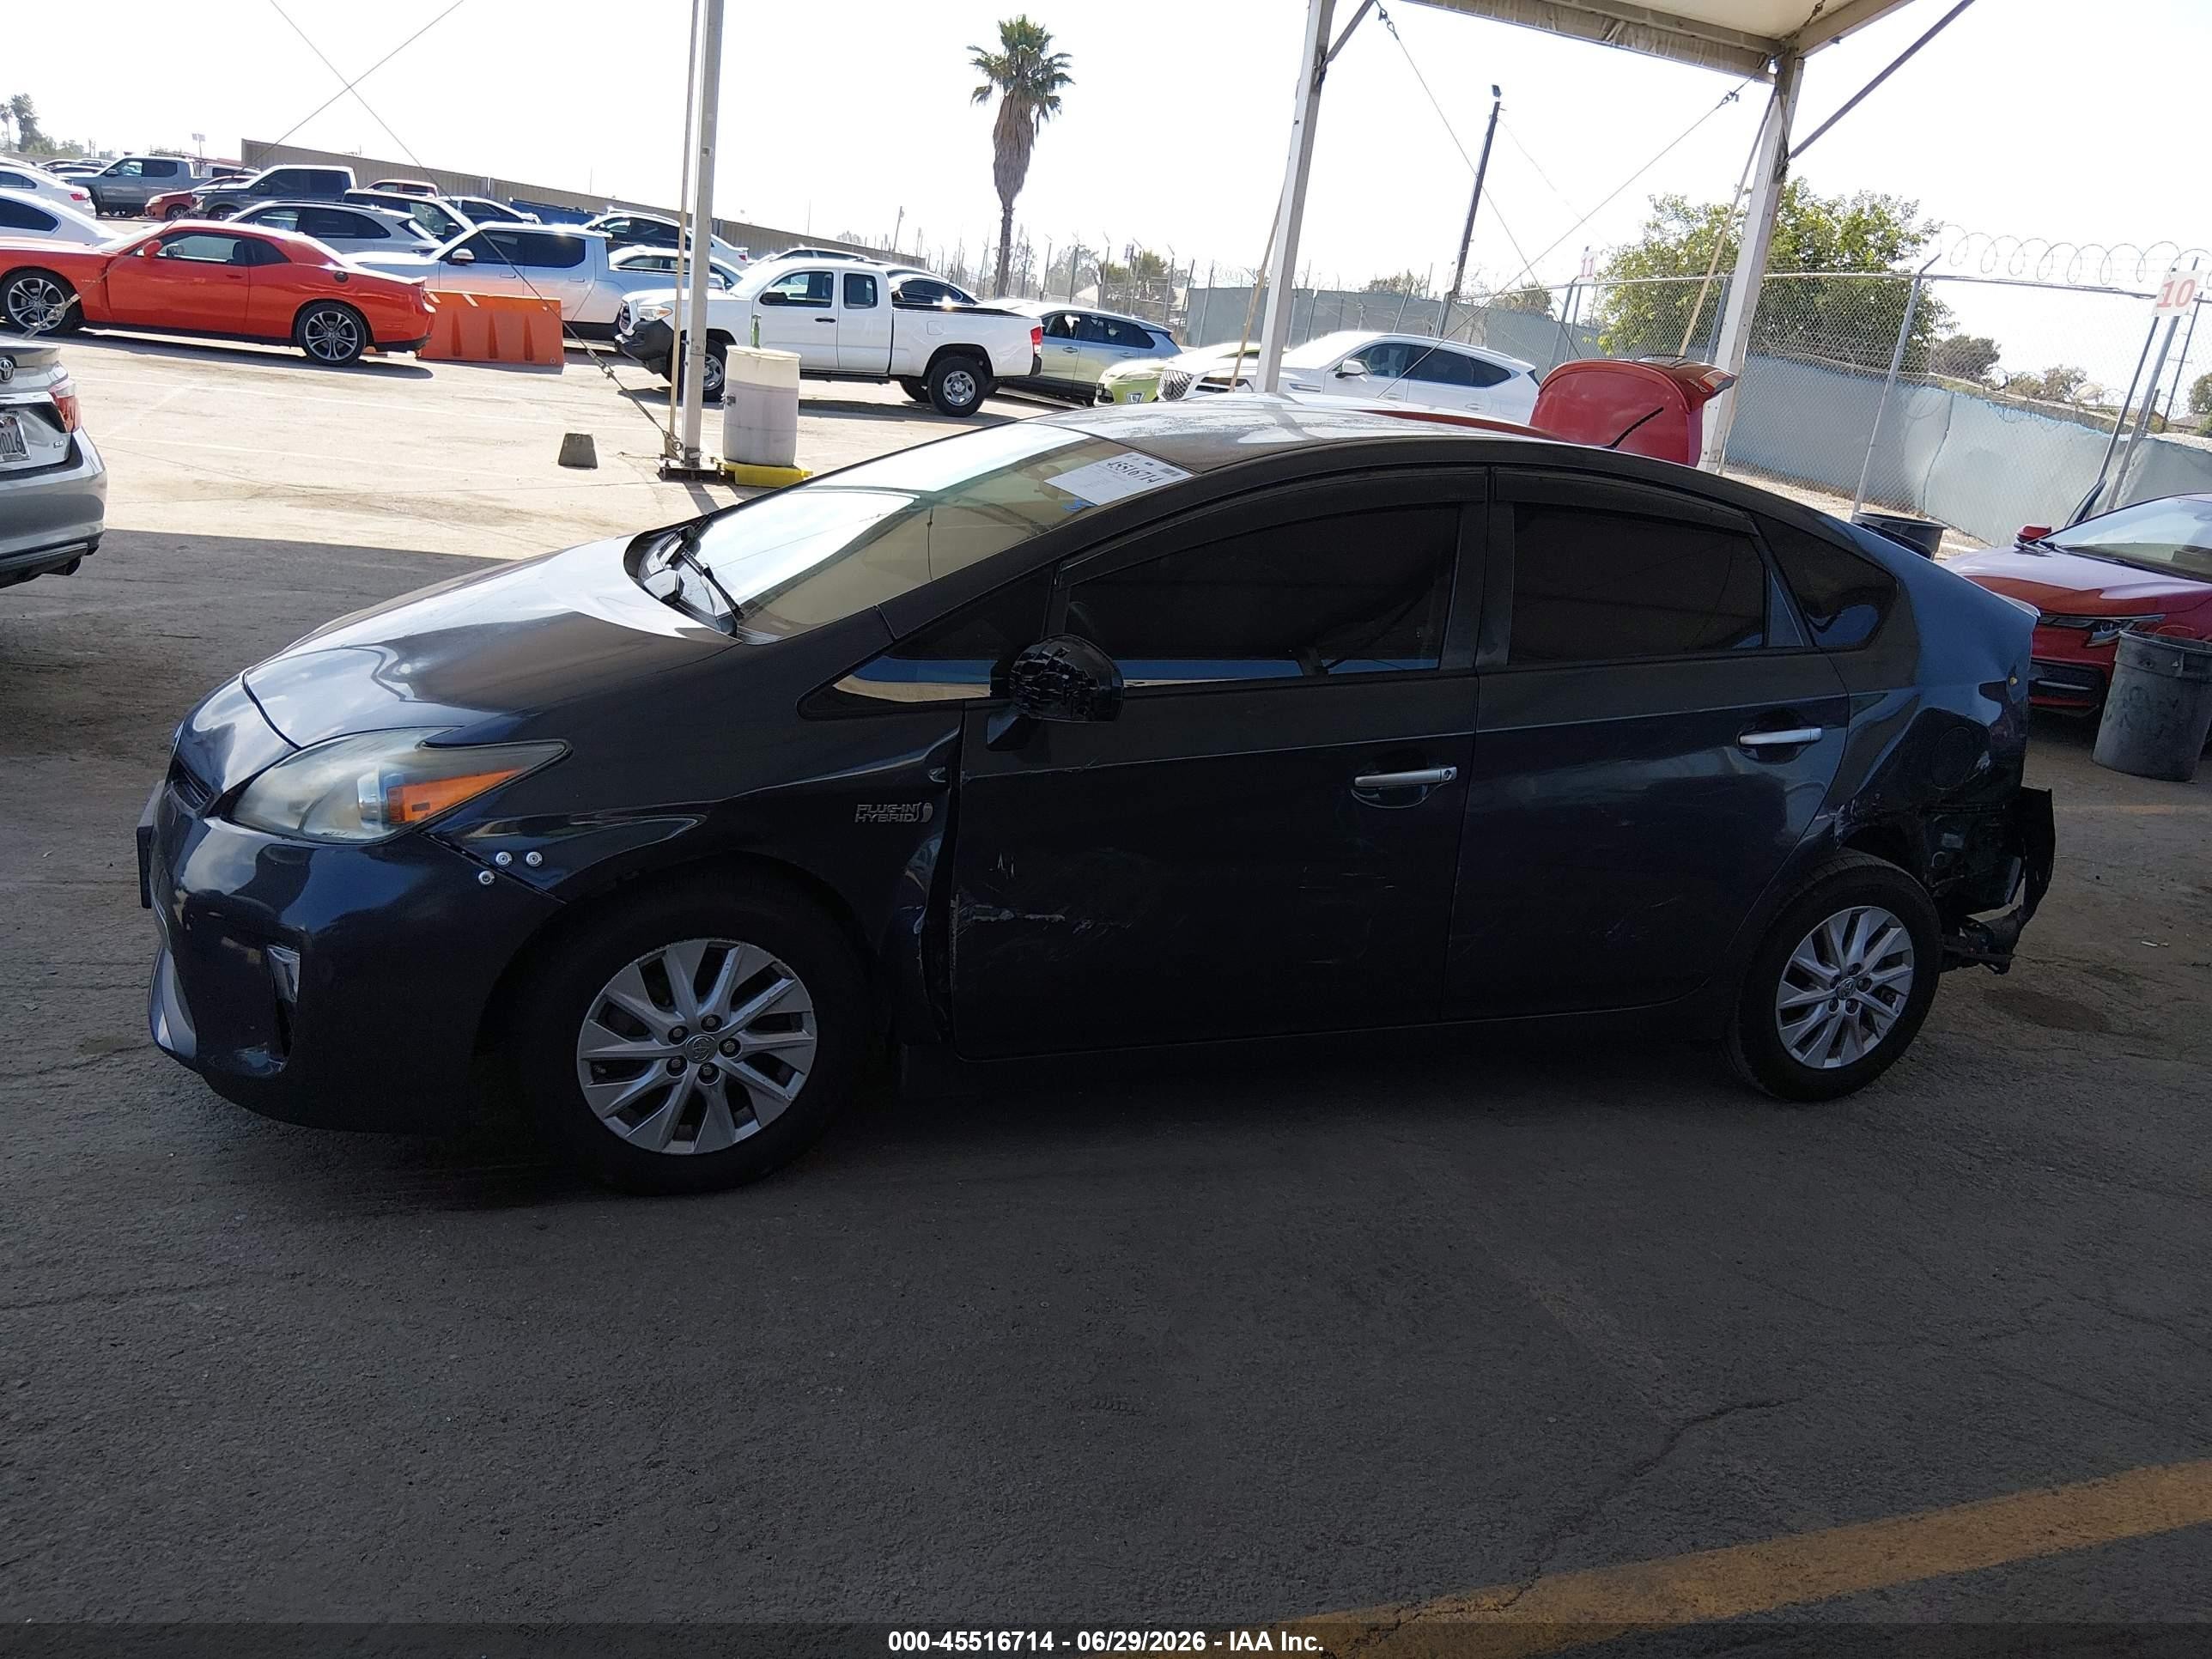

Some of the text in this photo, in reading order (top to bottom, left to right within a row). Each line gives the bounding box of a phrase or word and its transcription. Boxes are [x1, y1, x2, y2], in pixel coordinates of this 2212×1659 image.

[1580, 257, 1595, 277] 11
[2156, 279, 2196, 308] 10
[1106, 460, 1164, 483] 45516714
[854, 812, 915, 823] HYBRID
[857, 803, 916, 813] PLUG-IN
